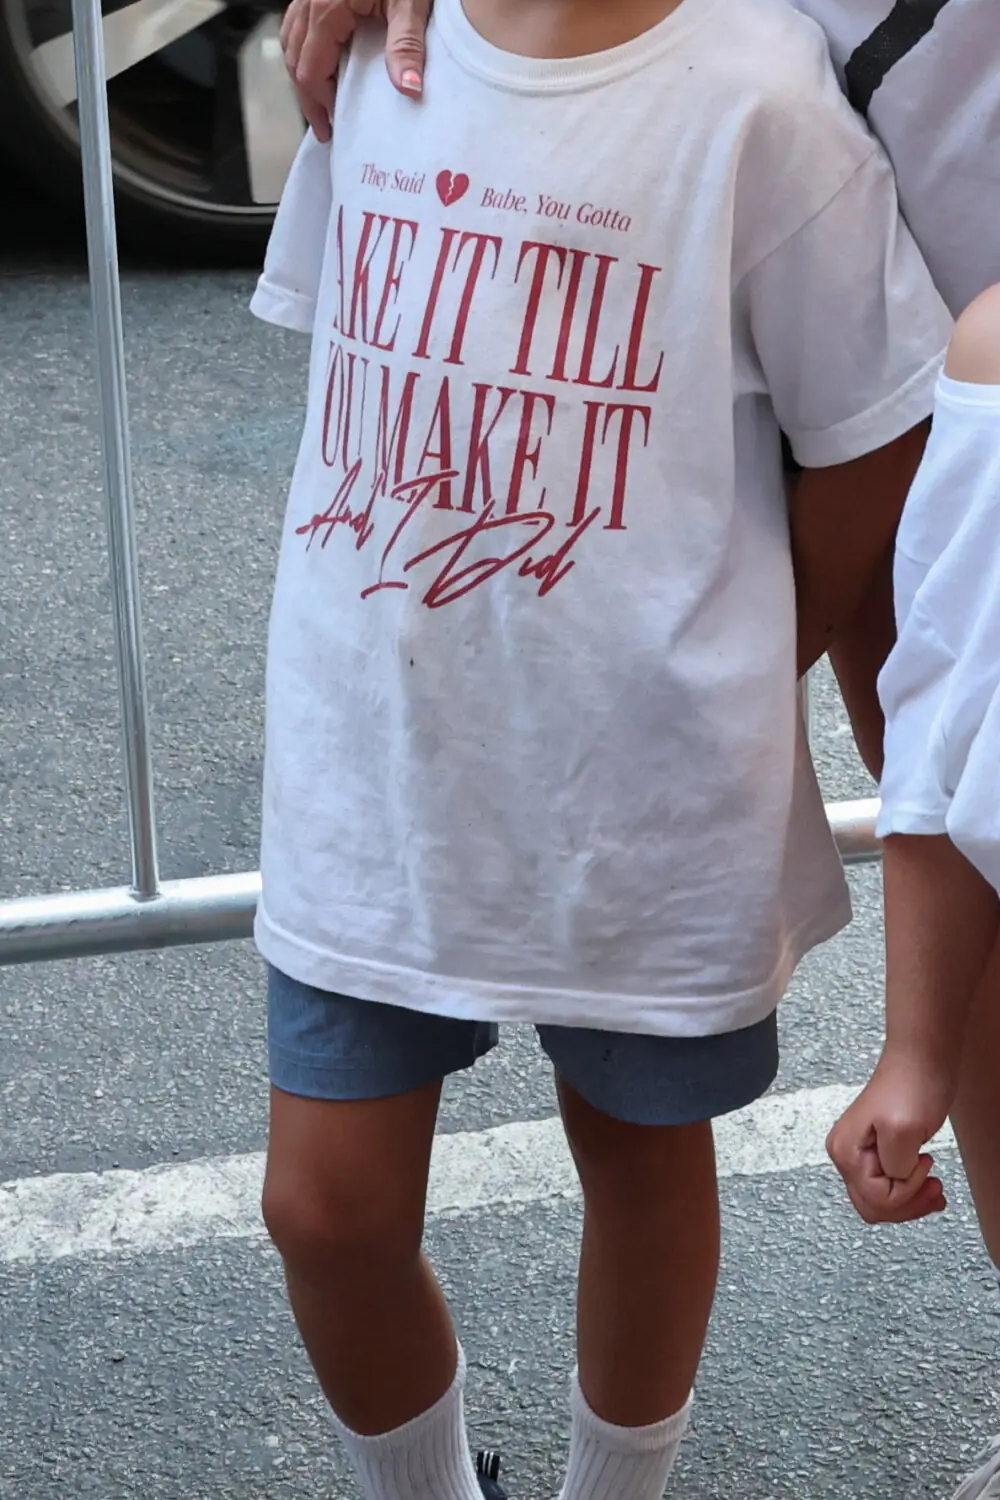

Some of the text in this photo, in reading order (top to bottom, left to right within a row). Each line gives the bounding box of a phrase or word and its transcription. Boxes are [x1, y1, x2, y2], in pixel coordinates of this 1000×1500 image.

[360, 164, 632, 232] They Said Babe, You Gotta
[333, 203, 664, 392] AKE IT TILL
[371, 364, 556, 524] MAKE
[566, 401, 651, 529] IT
